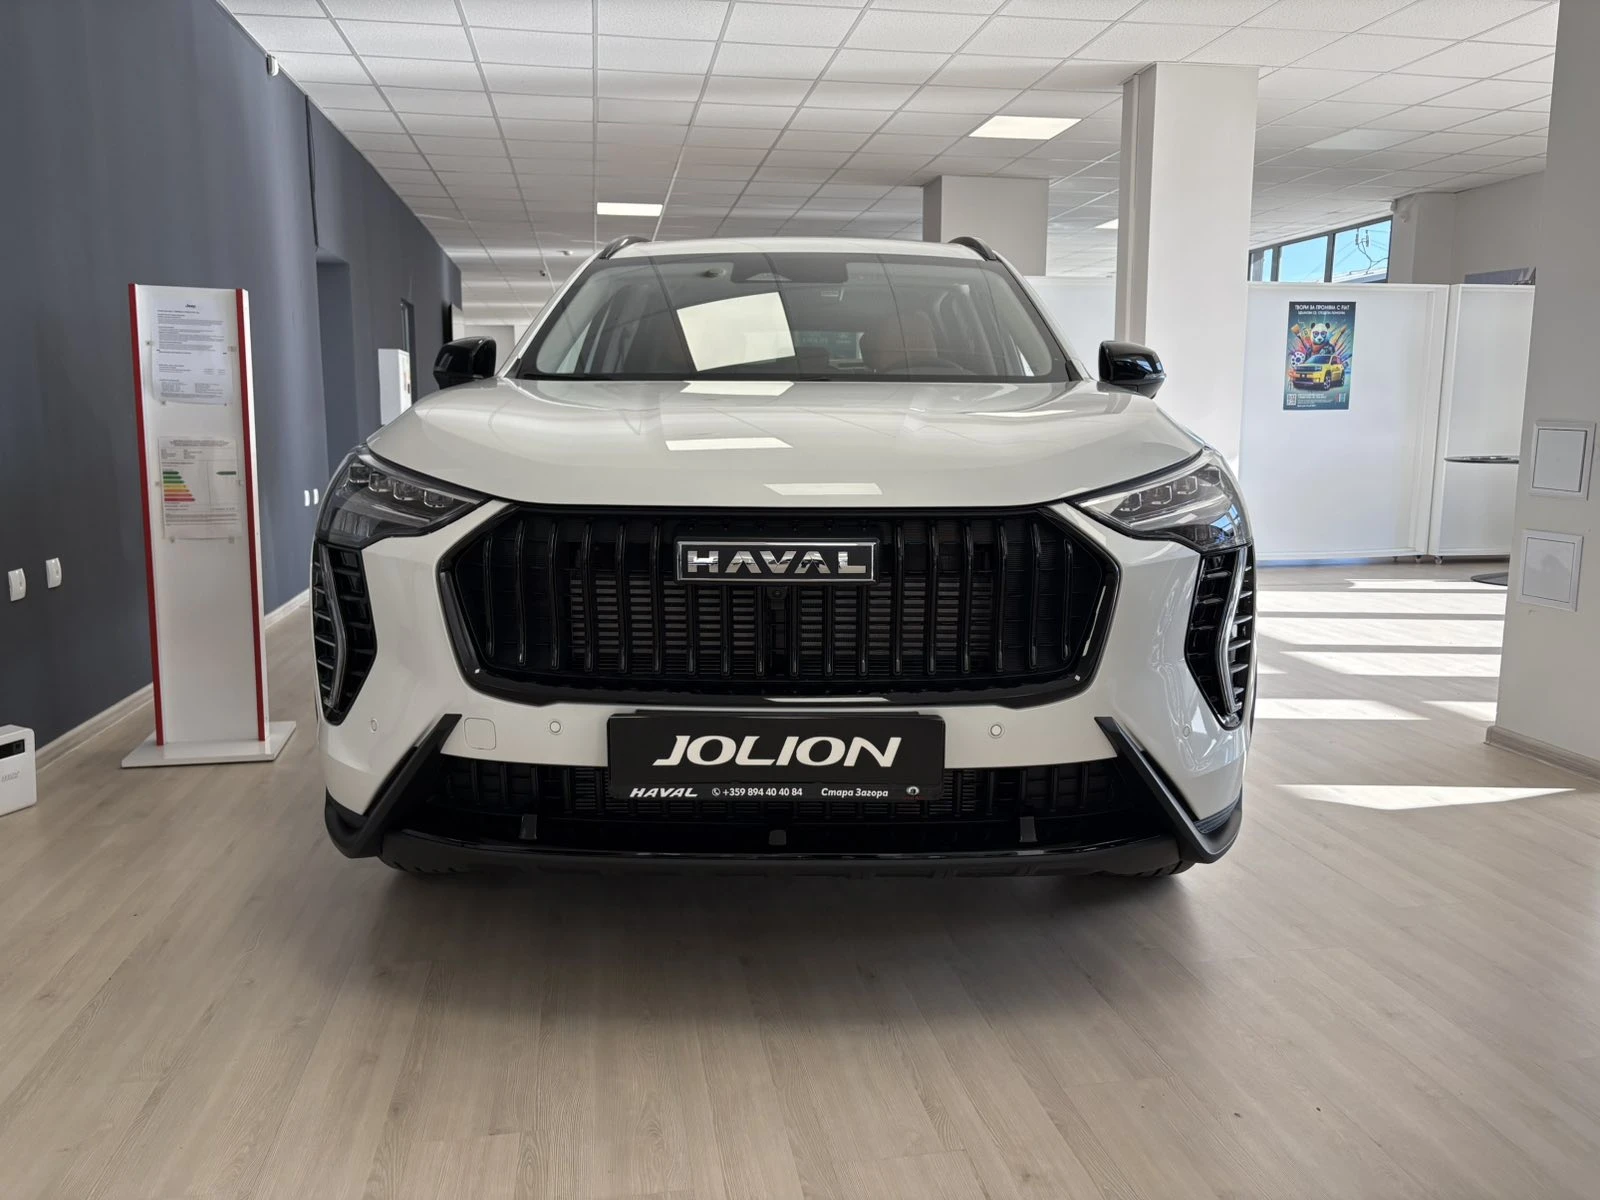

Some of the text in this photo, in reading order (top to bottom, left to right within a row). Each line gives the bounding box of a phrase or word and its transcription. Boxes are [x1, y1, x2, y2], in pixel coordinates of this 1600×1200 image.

[687, 550, 867, 574] HAVAL
[652, 735, 902, 768] JOLION
[629, 787, 699, 798] HAVAL
[722, 787, 803, 797] +359 894 40 40 84
[821, 787, 889, 799] Стара Загора
